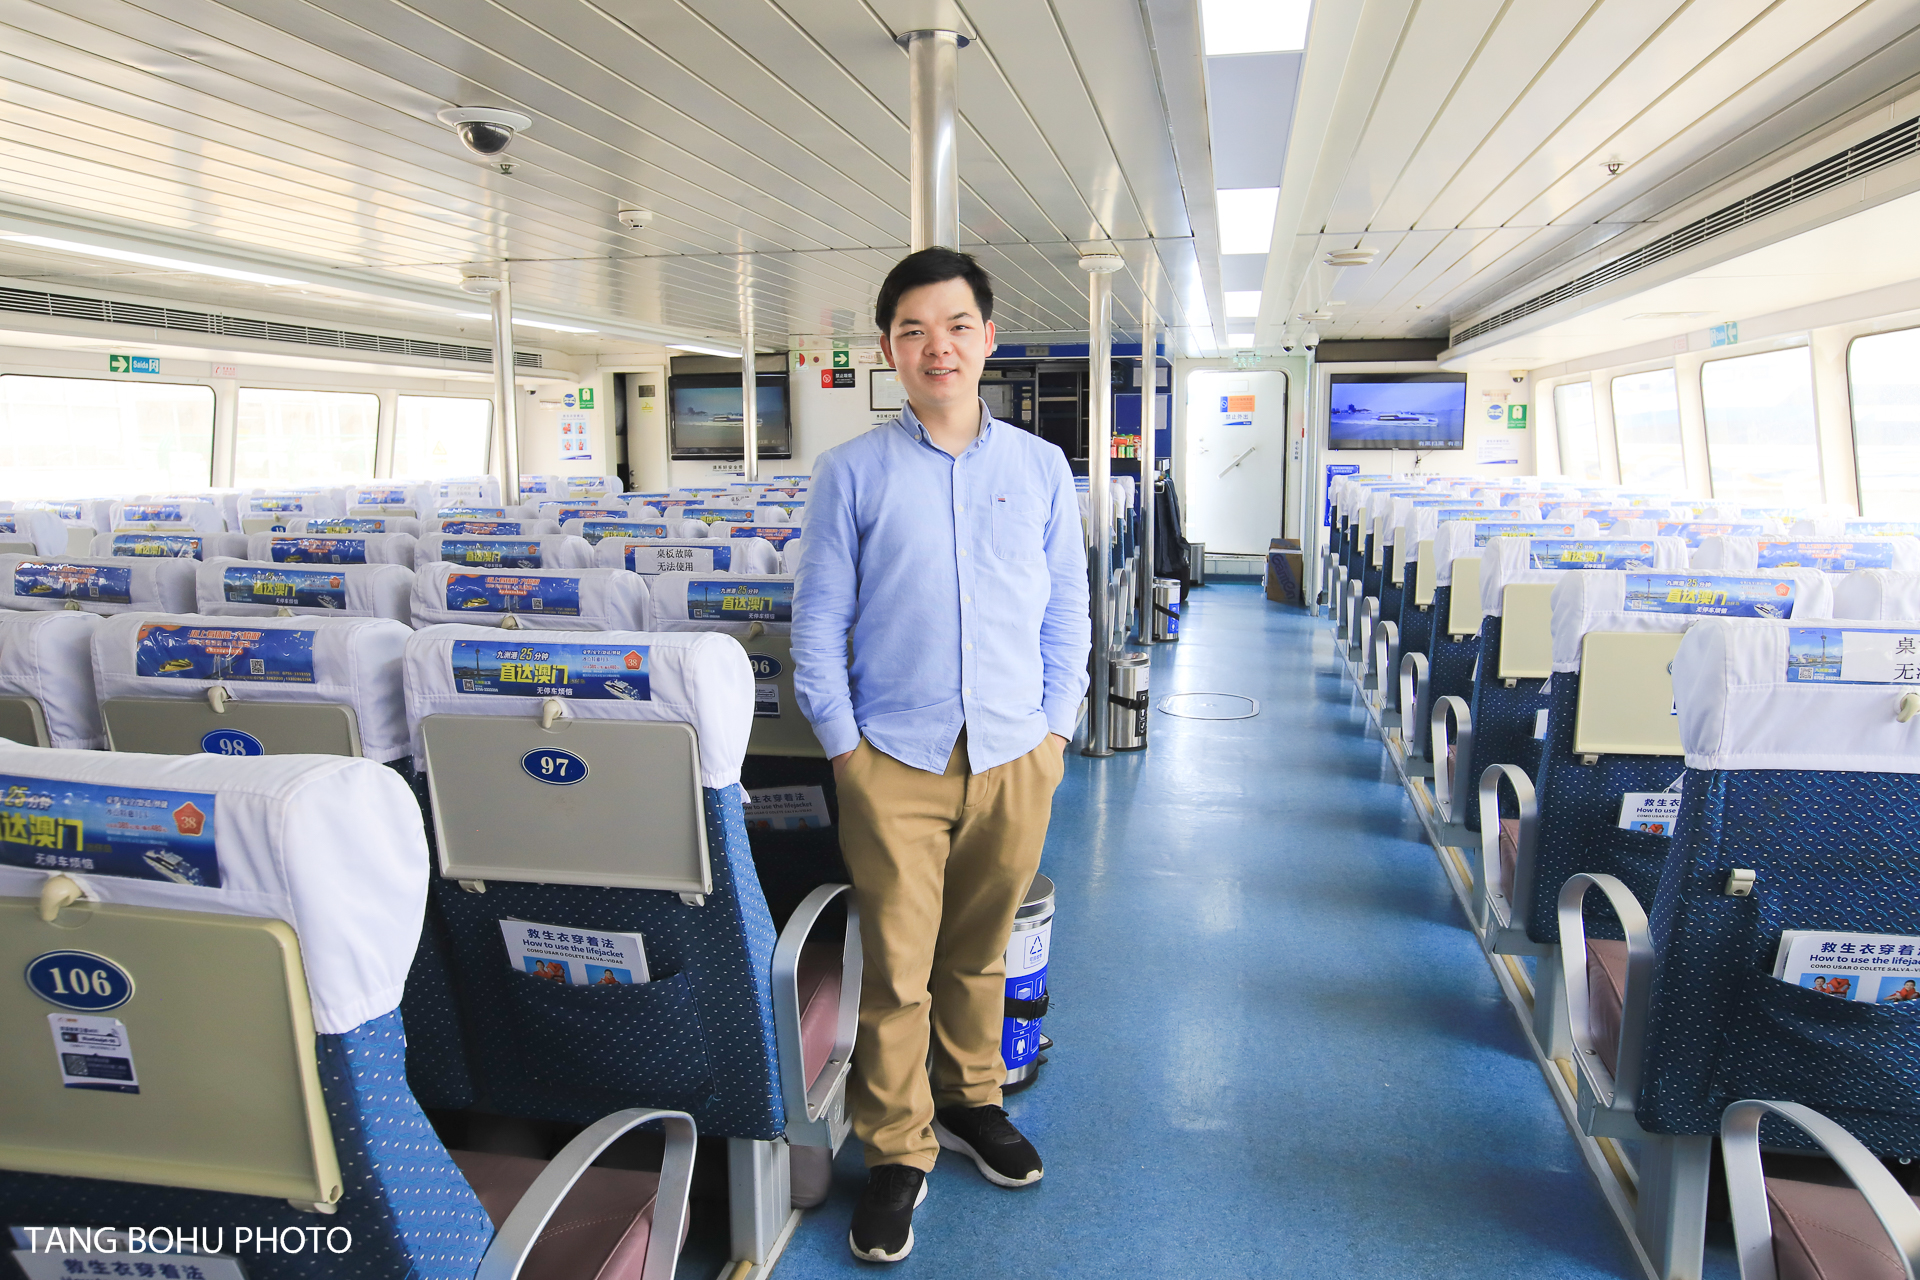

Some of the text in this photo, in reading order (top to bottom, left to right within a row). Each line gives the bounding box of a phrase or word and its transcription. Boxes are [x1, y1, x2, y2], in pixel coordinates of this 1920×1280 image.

[657, 549, 693, 558] 桌板故障
[657, 562, 693, 572] 无法使用
[1686, 578, 1698, 587] 25
[737, 585, 747, 595] 25
[1665, 588, 1728, 605] 直达澳门
[722, 596, 773, 611] 直达澳门
[520, 648, 534, 660] 25
[534, 652, 549, 661] 分钟
[628, 659, 638, 667] 38
[500, 662, 568, 684] 直达澳门
[536, 687, 573, 696] 无停车烦恼
[220, 738, 246, 756] 98
[540, 757, 569, 776] 97
[4, 786, 29, 807] 25
[750, 793, 805, 803] 生衣穿着法
[181, 817, 196, 828] 38
[36, 853, 94, 869] 无停车烦恼
[527, 928, 615, 949] 救生衣穿着法
[523, 939, 543, 947] How
[570, 945, 584, 953] the
[585, 947, 624, 959] lifejacket
[565, 952, 585, 960] COLETE
[585, 956, 624, 964] SALVA-VIDAS
[1892, 957, 1920, 966] lifeja
[49, 967, 112, 996] 106
